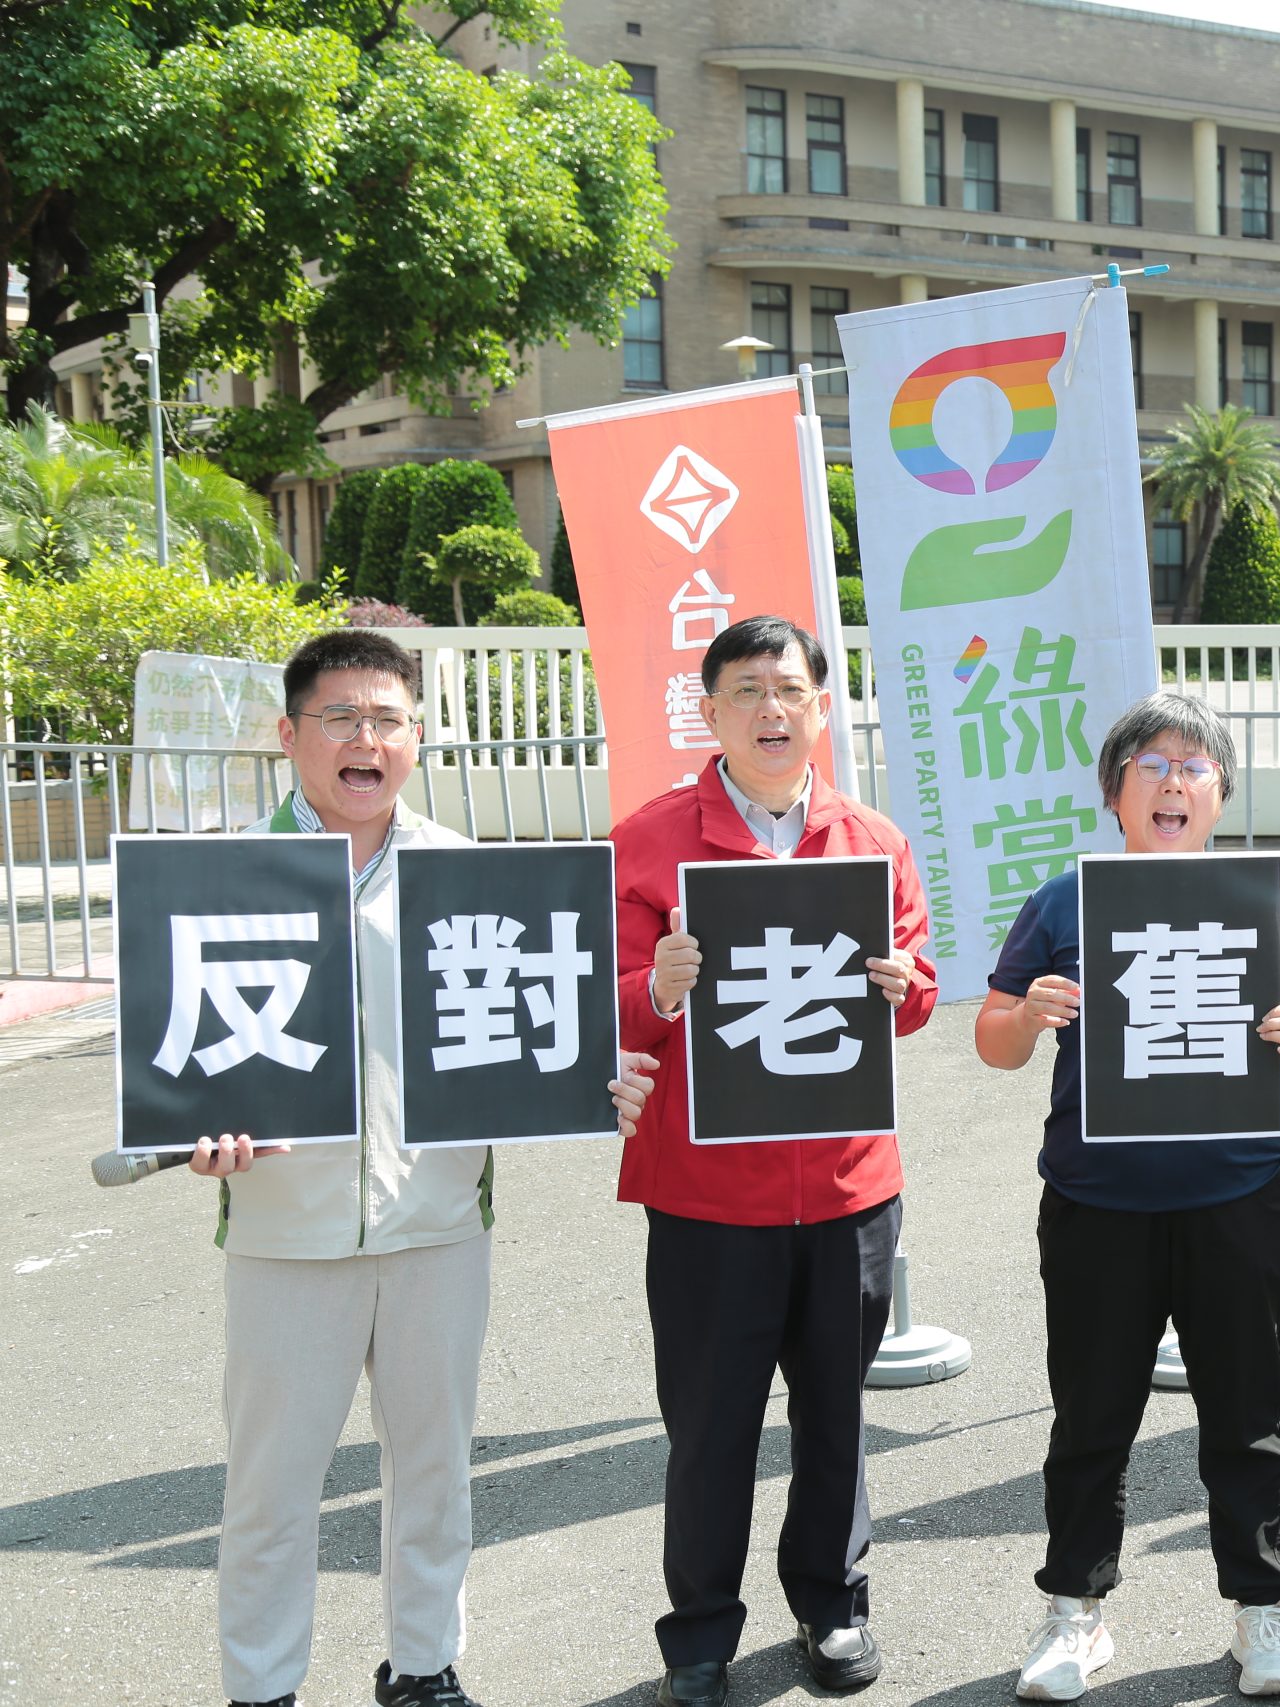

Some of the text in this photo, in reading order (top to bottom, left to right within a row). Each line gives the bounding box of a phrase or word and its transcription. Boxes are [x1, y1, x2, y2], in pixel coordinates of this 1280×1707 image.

[665, 568, 736, 789] 台灣
[901, 643, 958, 960] GREEN PARTY TAIWAN
[953, 625, 1098, 952] 綠黨
[152, 912, 328, 1077] 反
[427, 912, 592, 1072] 對
[715, 928, 867, 1075] 老
[1112, 922, 1257, 1079] 舊
